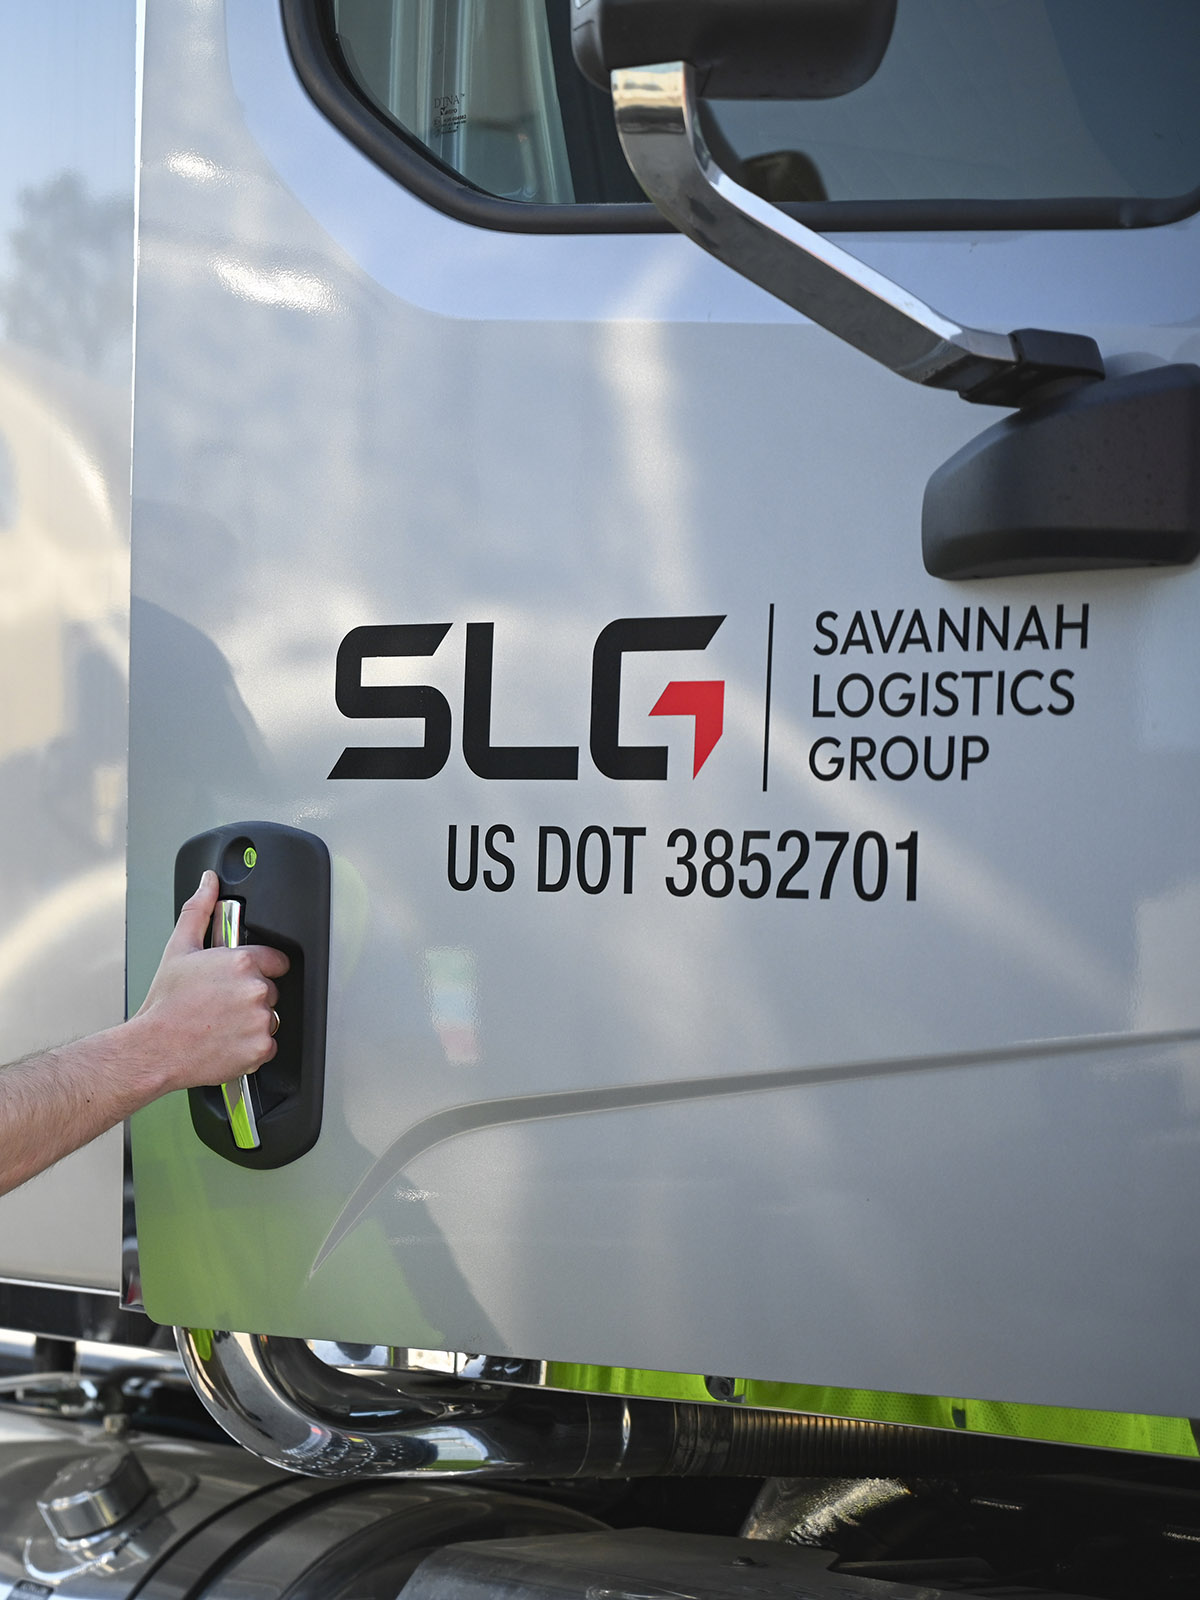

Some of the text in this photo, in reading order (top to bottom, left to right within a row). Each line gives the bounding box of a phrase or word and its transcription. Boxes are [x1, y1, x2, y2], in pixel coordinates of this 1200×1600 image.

[813, 602, 1090, 656] SAVANNAH
[326, 614, 728, 781] SLG
[812, 668, 1075, 718] LOGISTICS
[808, 735, 990, 782] GROUP
[447, 823, 919, 902] US DOT 3852701
